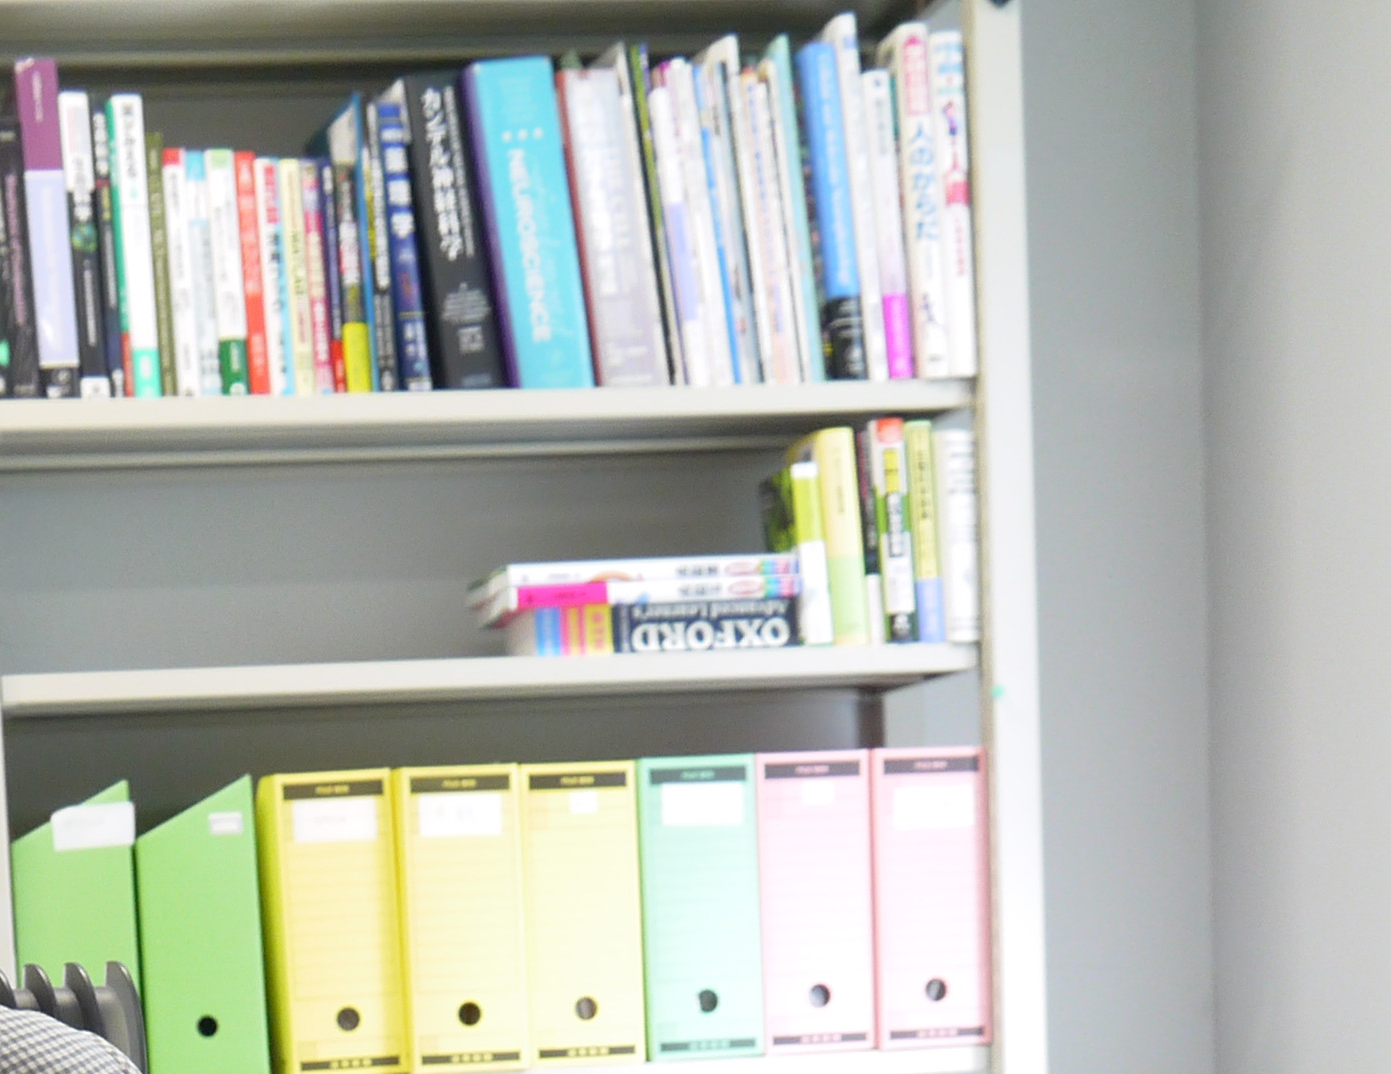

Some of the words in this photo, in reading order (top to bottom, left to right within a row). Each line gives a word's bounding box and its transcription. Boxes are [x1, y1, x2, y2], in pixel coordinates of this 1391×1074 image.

[908, 120, 939, 240] 人のからだ
[508, 148, 552, 343] NEUROSCIENCE
[631, 617, 791, 651] OXFORD
